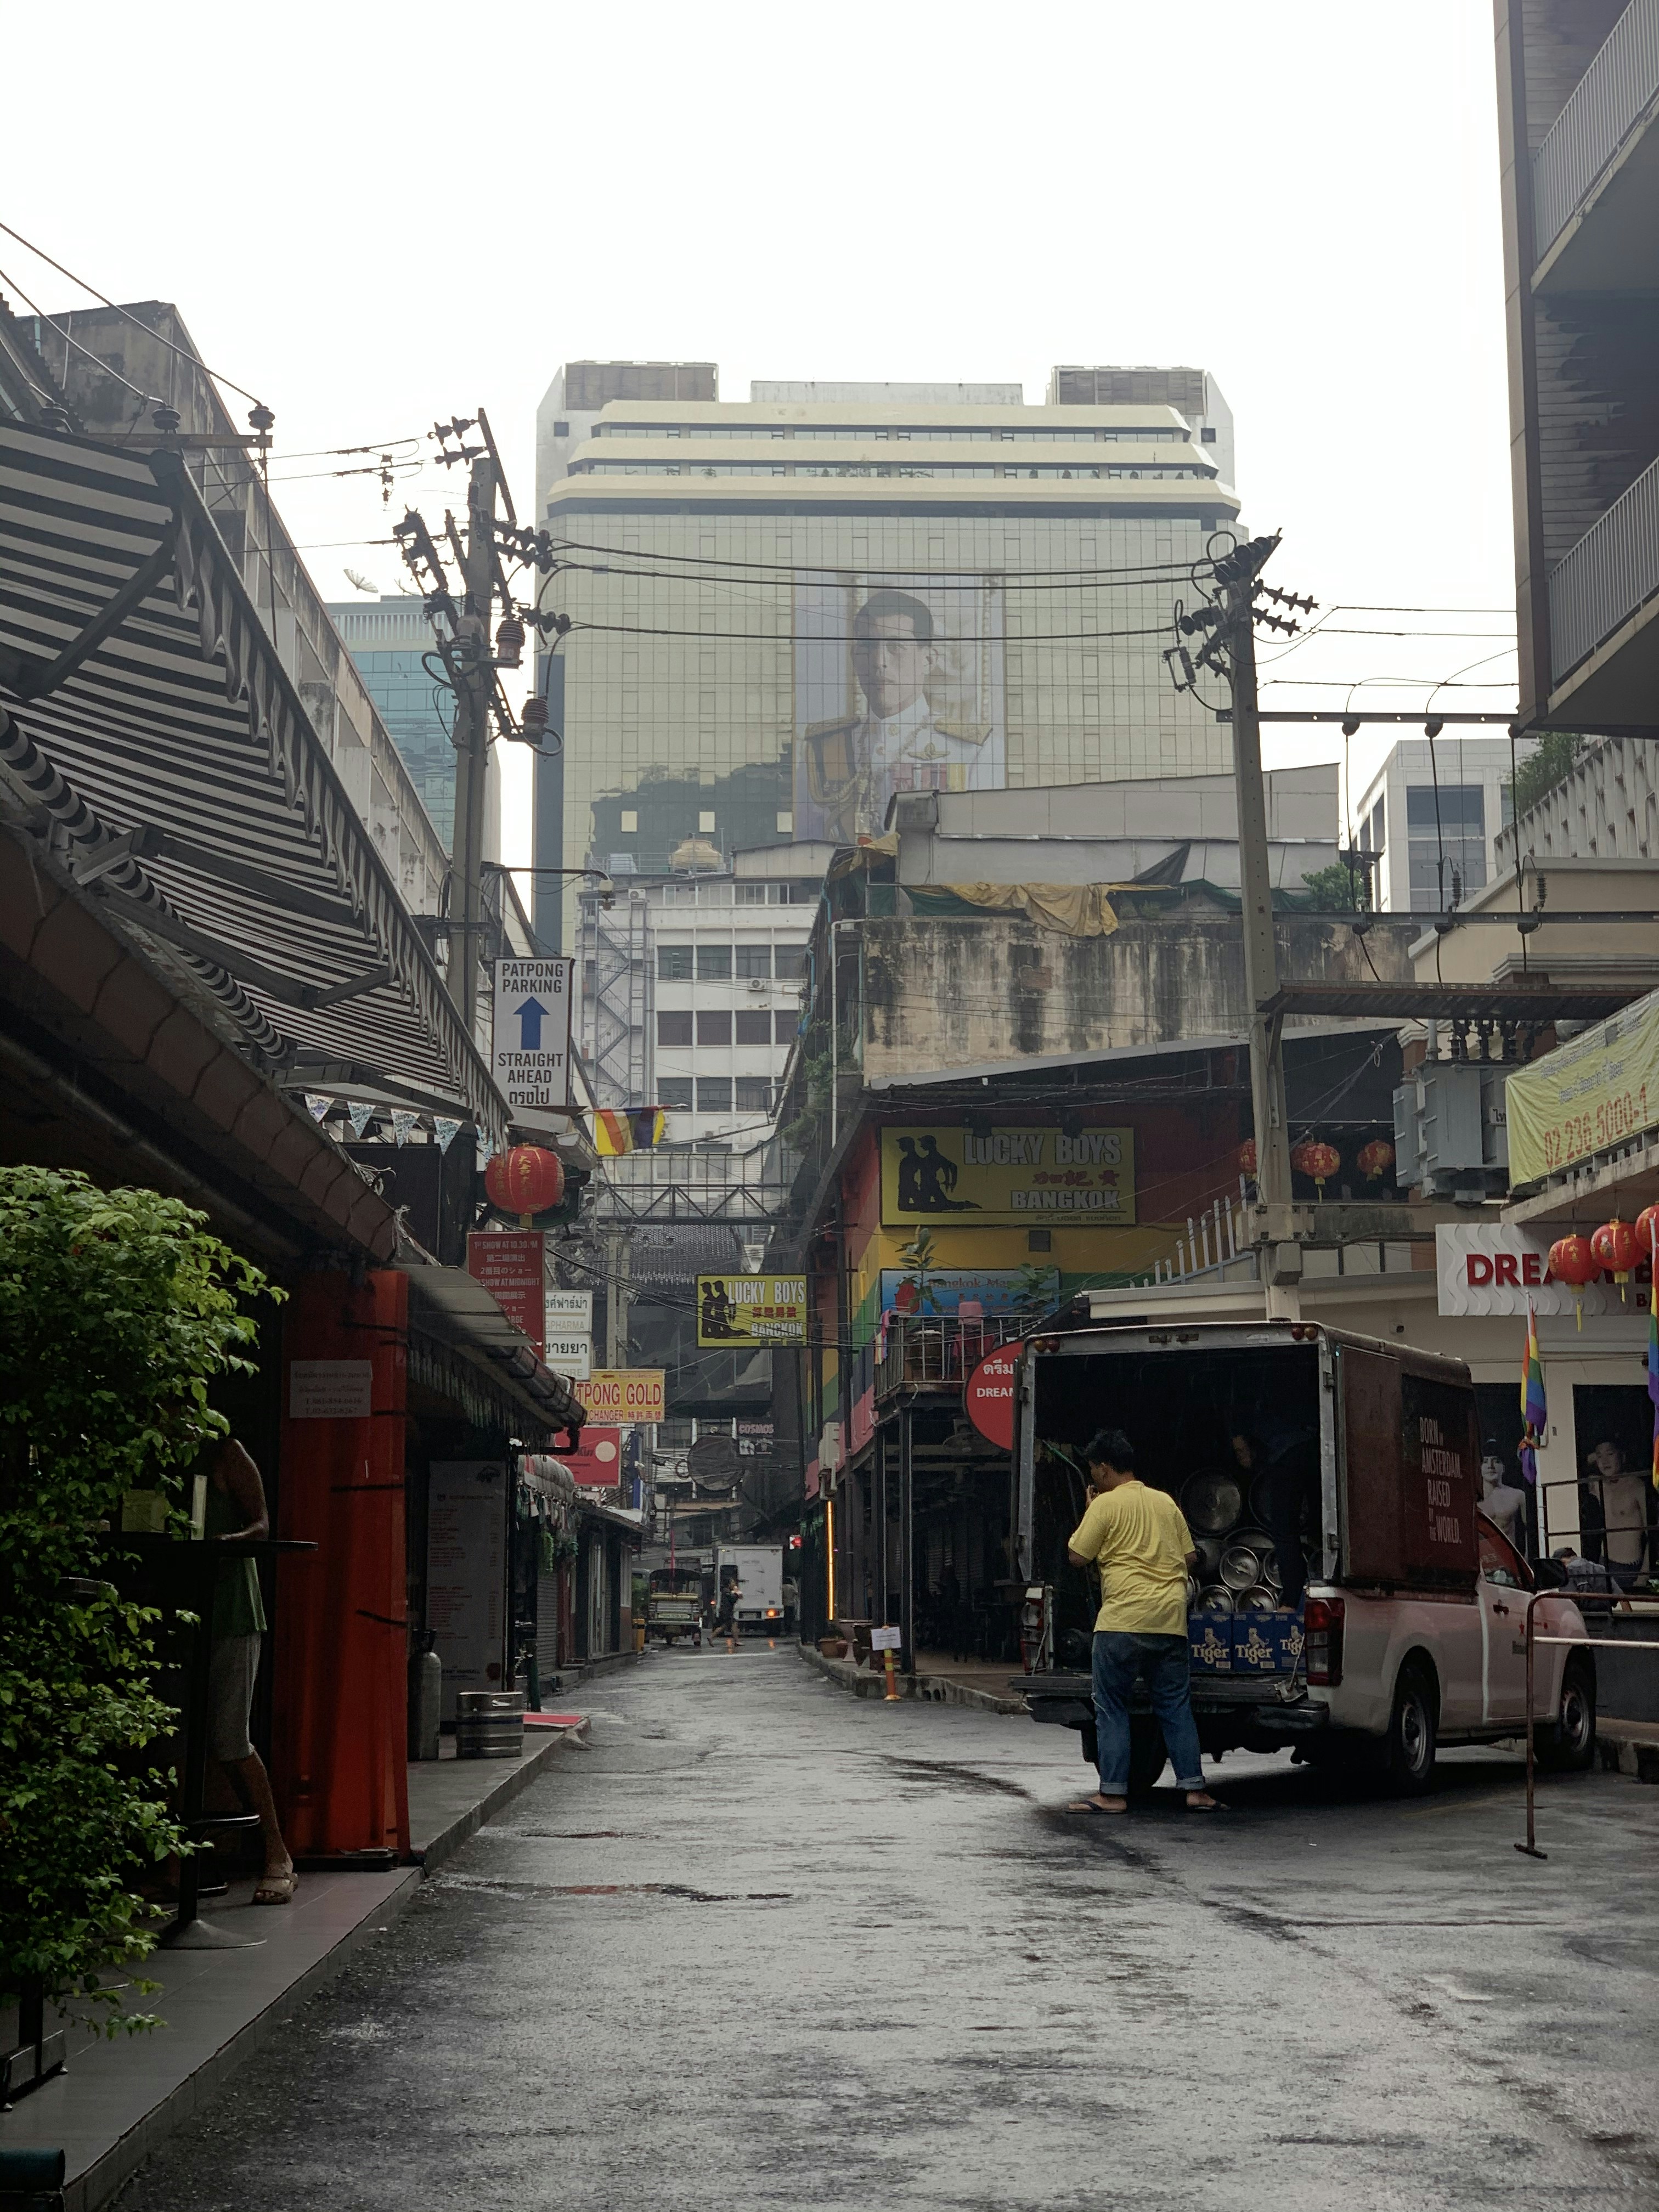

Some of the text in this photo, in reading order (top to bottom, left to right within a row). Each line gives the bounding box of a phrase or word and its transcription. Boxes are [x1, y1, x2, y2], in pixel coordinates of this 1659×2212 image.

[501, 963, 563, 978] PATPONG
[502, 979, 562, 994] PARKING
[498, 1053, 564, 1068] STRAIGHT
[507, 1069, 552, 1084] AHEAD
[509, 1085, 550, 1105] ตรงไป
[1544, 1082, 1649, 1169] 02 236 5000-1
[964, 1134, 1121, 1165] LUCKY BOYS
[1011, 1190, 1120, 1209] BANGKOK
[482, 1241, 501, 1250] SHOW
[502, 1241, 509, 1249] AT
[509, 1278, 540, 1286] MIDNIGHT
[727, 1281, 805, 1304] LUCKY BOYS
[751, 1323, 803, 1337] BANGKOK
[575, 1383, 662, 1406] TPONG GOLD
[589, 1409, 624, 1421] CHANGER
[1419, 1417, 1439, 1446] BORN
[1427, 1479, 1451, 1508] RAISED
[1191, 1643, 1229, 1664] Tiger
[1234, 1643, 1273, 1664] Tiger
